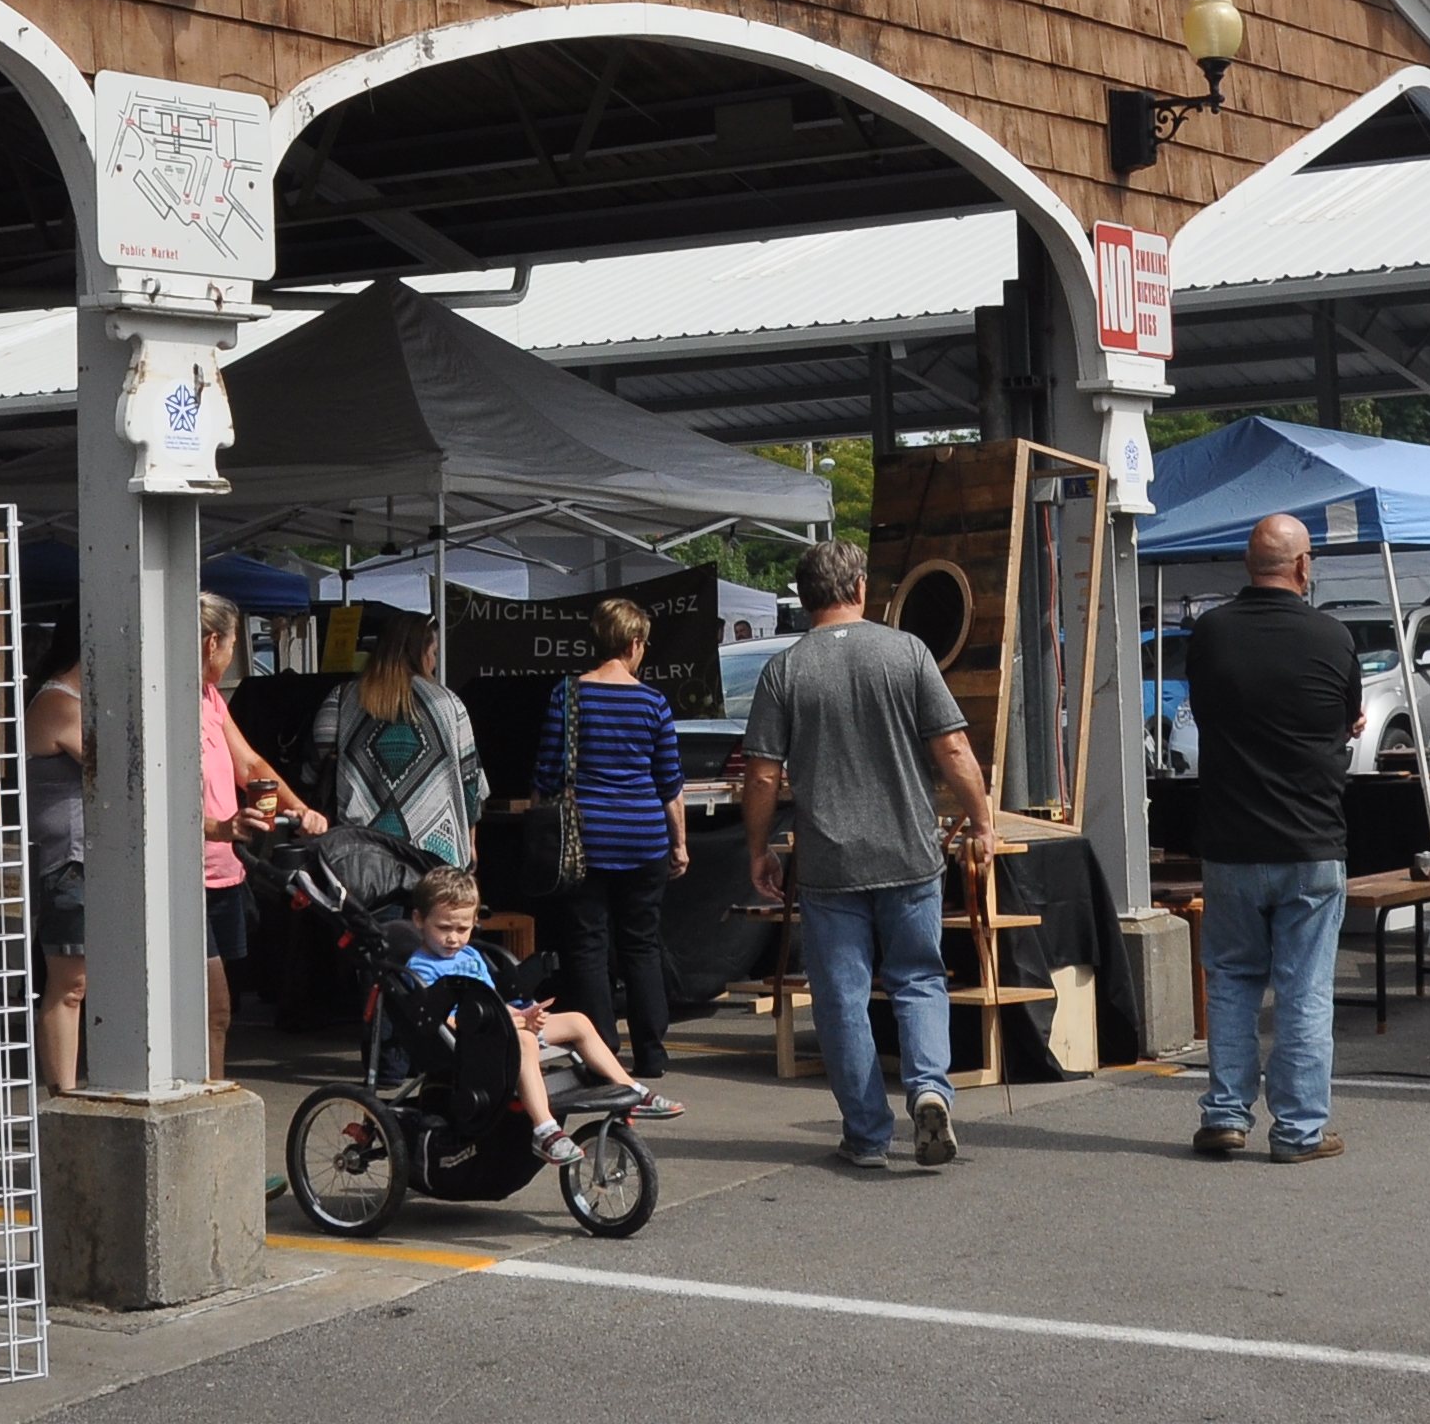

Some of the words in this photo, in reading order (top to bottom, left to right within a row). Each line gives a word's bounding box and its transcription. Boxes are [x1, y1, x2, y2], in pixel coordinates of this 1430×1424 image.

[120, 243, 145, 258] Public
[151, 247, 178, 261] Market
[1136, 249, 1167, 276] SMOKING
[1099, 241, 1134, 334] NO
[1136, 280, 1167, 307] BICYCLES
[1138, 312, 1157, 337] DOGS
[471, 599, 589, 620] MICHELL
